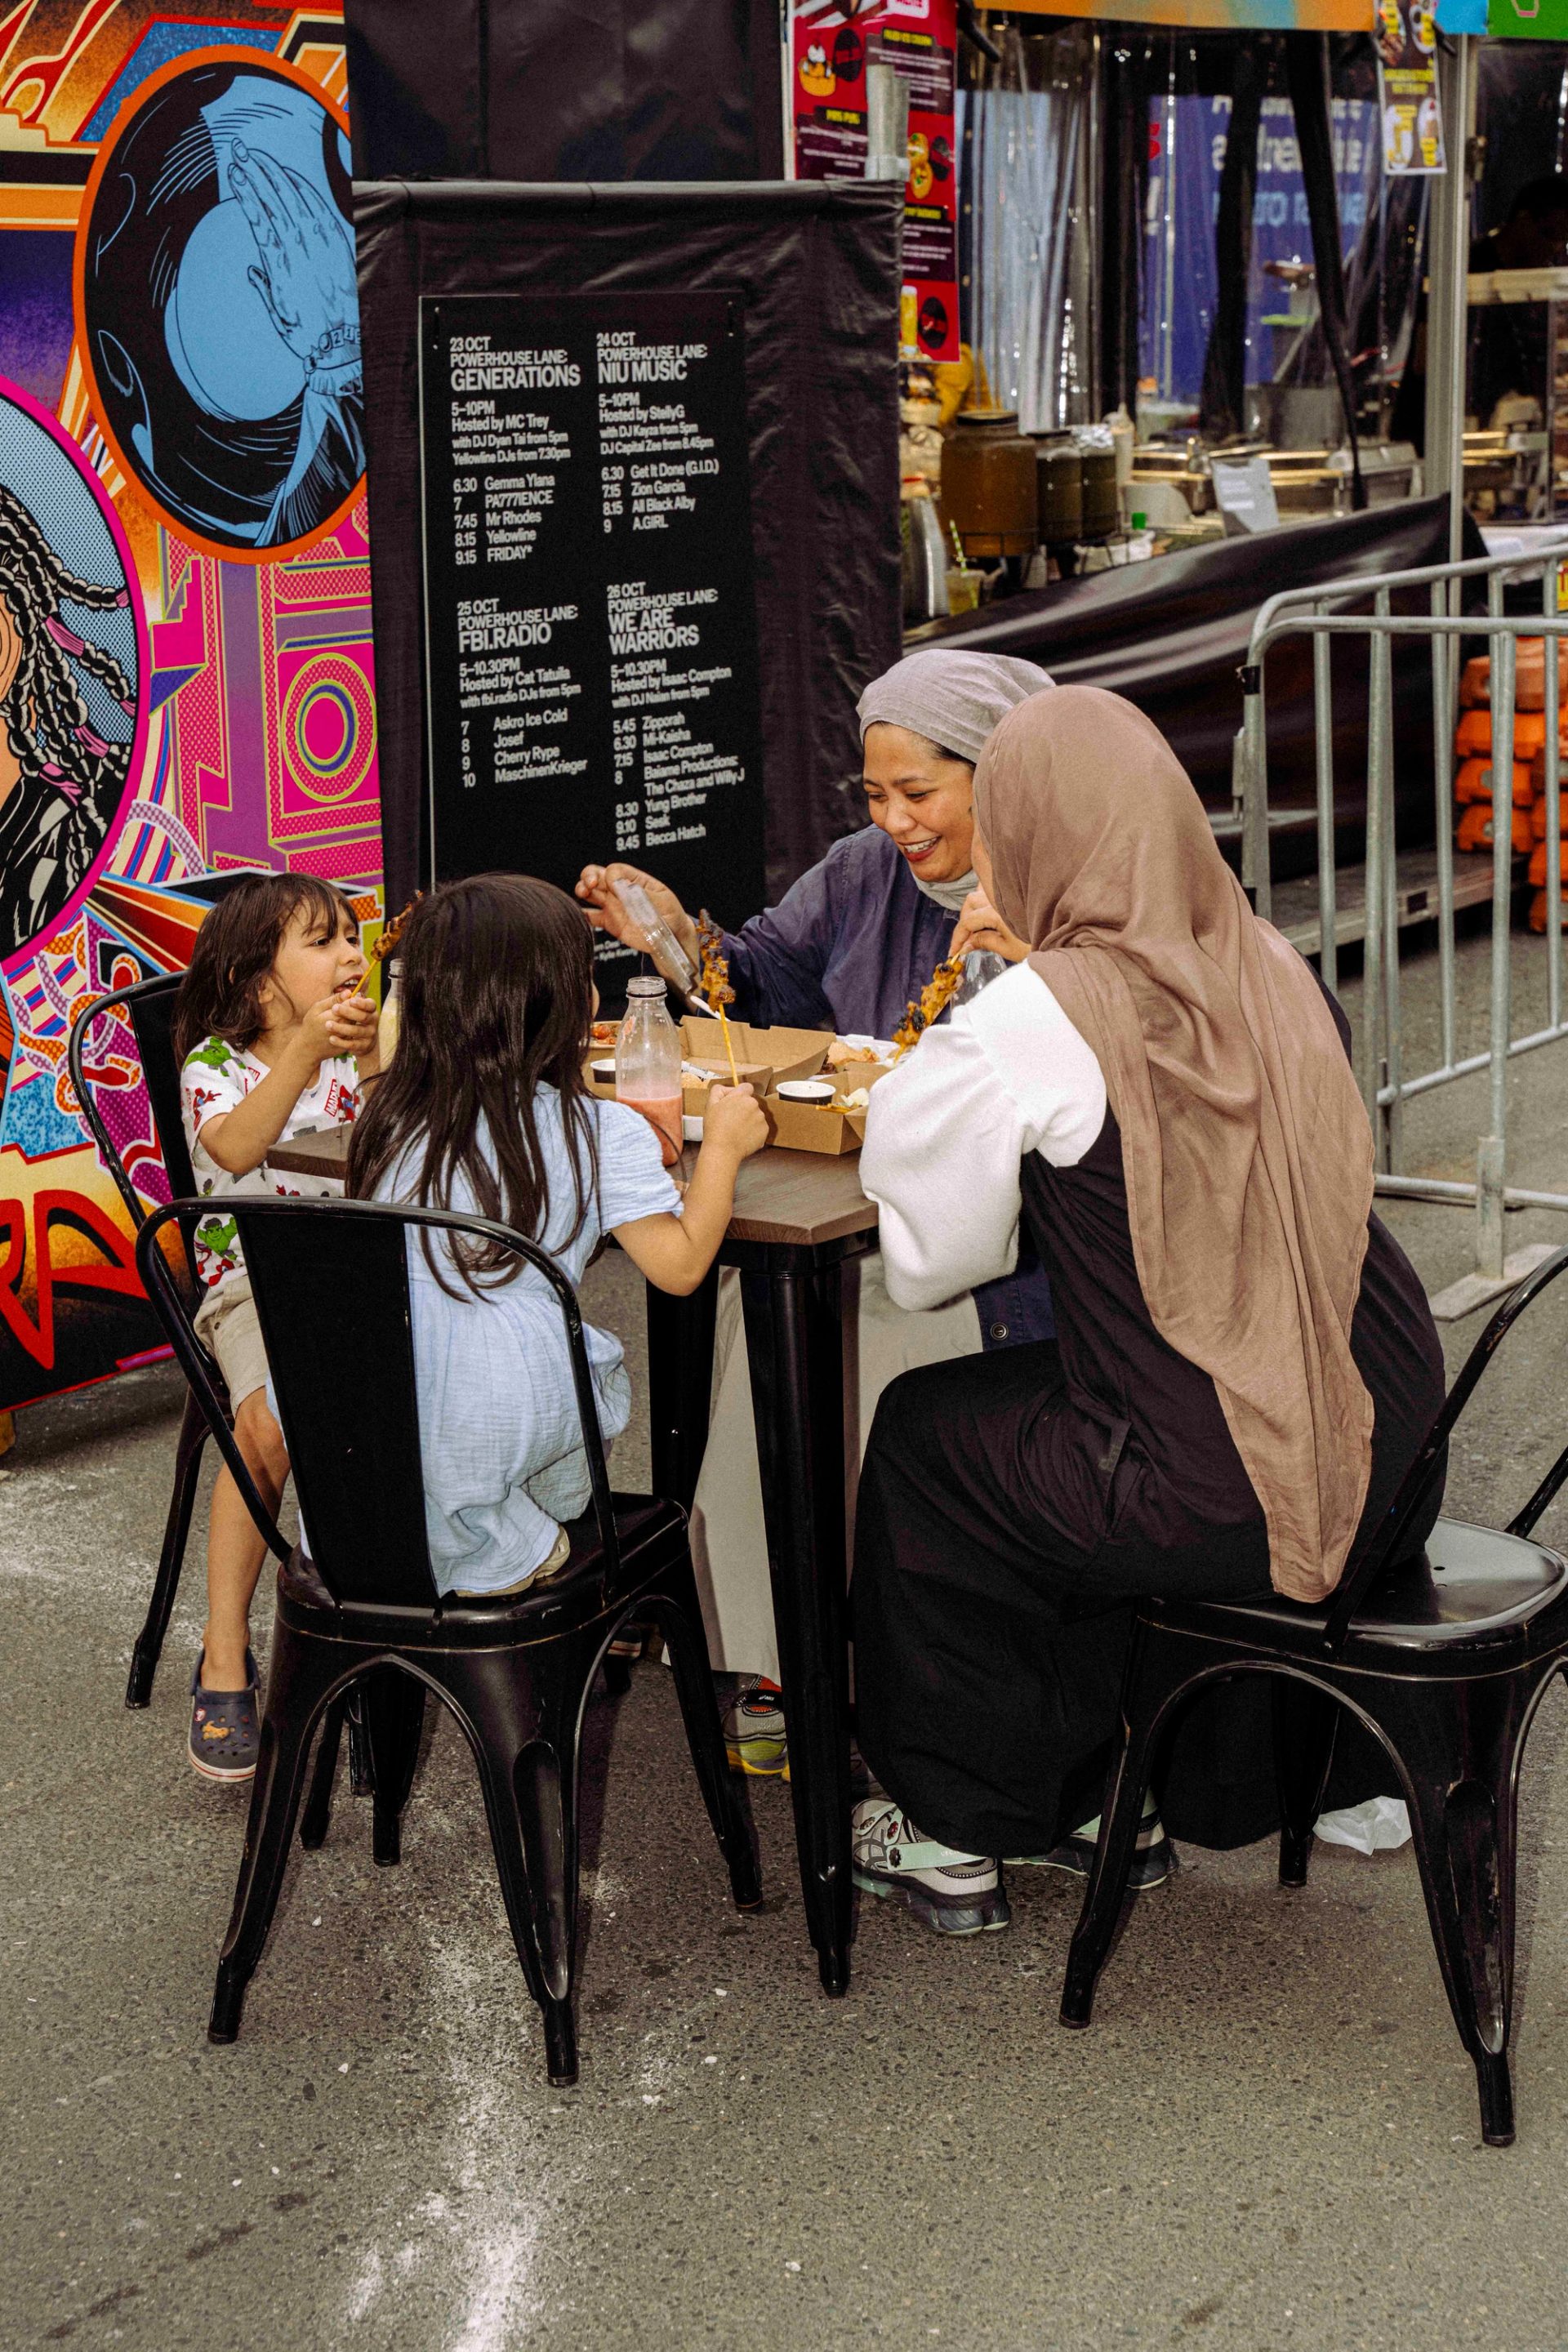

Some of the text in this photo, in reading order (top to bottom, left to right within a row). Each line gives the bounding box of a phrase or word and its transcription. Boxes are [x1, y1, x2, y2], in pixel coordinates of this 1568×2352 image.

[450, 336, 491, 352] 23 OCT
[596, 332, 636, 347] 24 OCT
[450, 350, 532, 368] POWERHOUSE
[597, 345, 675, 362] POWERHOUSE
[451, 364, 581, 391] GENERATIONS
[598, 359, 688, 384] NIU MUSIC
[452, 413, 549, 433] Hosted by MC Trey
[599, 408, 635, 422] Hosted
[635, 408, 648, 423] by
[452, 430, 568, 448] with DJ Dyan Tai from 5pm
[599, 426, 618, 439] with
[618, 425, 633, 438] DJ
[659, 423, 679, 434] from
[679, 421, 698, 435] 5pm
[600, 436, 714, 456] DJ Capital Zee from 8.45pm
[452, 447, 571, 466] Yellowline DJs from 7.30pm
[601, 466, 624, 481] 6.30
[630, 465, 649, 479] Get
[659, 463, 685, 477] Done
[453, 477, 478, 493] 6.30
[484, 476, 525, 491] Gemma
[602, 479, 686, 498] 7.15 Zion Garcia
[453, 497, 462, 511] 7
[603, 501, 623, 515] 8.15
[632, 499, 645, 513] All
[646, 497, 674, 512] Black
[454, 510, 541, 529] 7.45 Mr Rhodes
[604, 519, 612, 533] 9
[455, 528, 537, 547] 8.15 Yellowline
[456, 550, 477, 565] 9.15
[607, 581, 646, 599] 26 OCT
[457, 598, 499, 616] 25 OCT
[608, 592, 686, 613] POWERHOUSE
[458, 608, 542, 631] POWERHOUSE
[608, 607, 675, 634] WE ARE
[459, 622, 551, 653] FBI.RADIO
[608, 625, 699, 655] WARRIORS
[460, 675, 499, 693] Hosted
[500, 674, 514, 689] by
[515, 670, 535, 685] Cat
[612, 666, 732, 693] Hosted by Isaac Compton
[460, 695, 480, 708] with
[519, 688, 538, 701] DJs
[539, 686, 560, 698] from
[560, 683, 581, 697] 5pm
[612, 696, 630, 708] with
[631, 693, 645, 706] DJ
[670, 688, 691, 700] from
[690, 685, 710, 699] 5pm
[461, 707, 568, 735] 7 Askro Ice Cold
[613, 718, 636, 734] 5.45
[461, 731, 524, 753] 8 Josef
[613, 735, 637, 751] 6.30
[462, 746, 559, 770] 9 Cherry Rype
[614, 743, 714, 768] 7.15 Isaac Compton
[681, 755, 738, 773] Productions:
[462, 773, 476, 787] 10
[644, 782, 664, 796] The
[696, 773, 715, 788] and
[714, 770, 737, 785] Willy
[737, 768, 745, 782] J
[616, 801, 639, 818] 8.30
[644, 799, 670, 813] Yung
[616, 818, 636, 835] 9.10
[617, 824, 706, 851] 9.45 Becca Hatch
